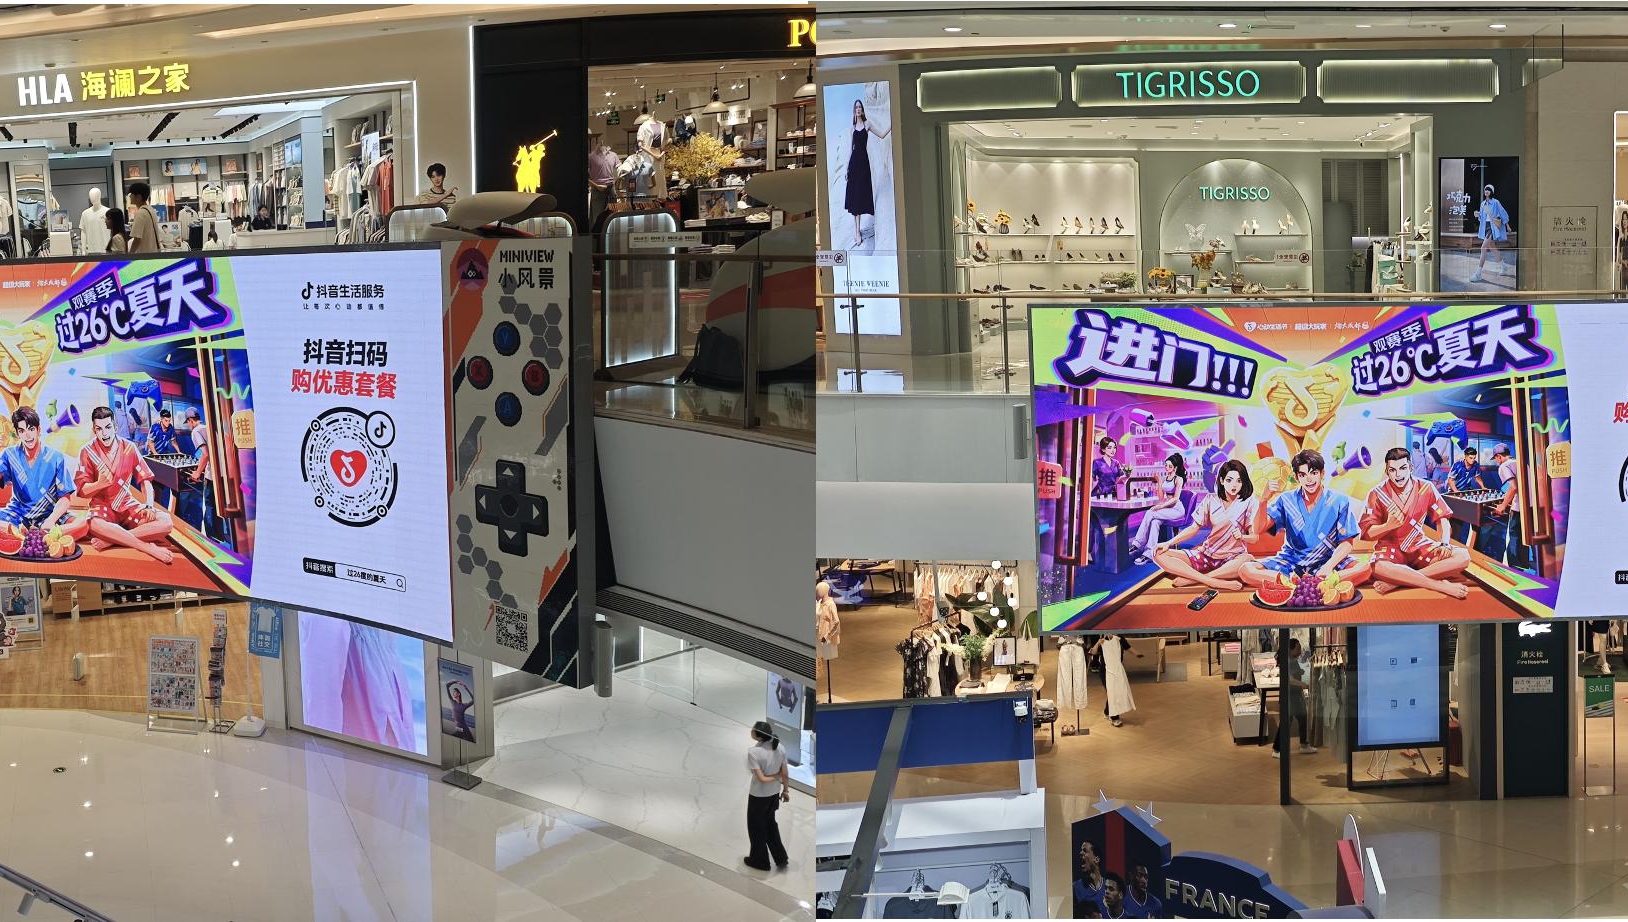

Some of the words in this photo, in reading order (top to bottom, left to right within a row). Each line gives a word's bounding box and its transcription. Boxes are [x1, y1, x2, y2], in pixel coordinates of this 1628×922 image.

[18, 73, 73, 107] HLA
[80, 65, 191, 101] 海澜之家
[1116, 69, 1260, 99] TIGRISSO
[1199, 185, 1270, 201] TIGRISSO
[1446, 191, 1471, 203] 巧克力
[499, 250, 555, 263] MINIVIEW
[497, 267, 555, 290] 小风景
[71, 278, 117, 310] 观赛季
[316, 284, 384, 299] 抖音生活服务
[1372, 321, 1428, 353] 观赛季
[303, 339, 388, 367] 抖音扫码
[291, 368, 397, 400] 购优惠套餐
[235, 418, 251, 435] 推
[1550, 450, 1567, 466] 推
[1038, 468, 1057, 487] 推
[305, 560, 334, 575] 抖音搜索
[347, 568, 387, 584] 过26度的夏天
[1588, 685, 1610, 693] SALE
[1165, 877, 1271, 919] FRANCE
